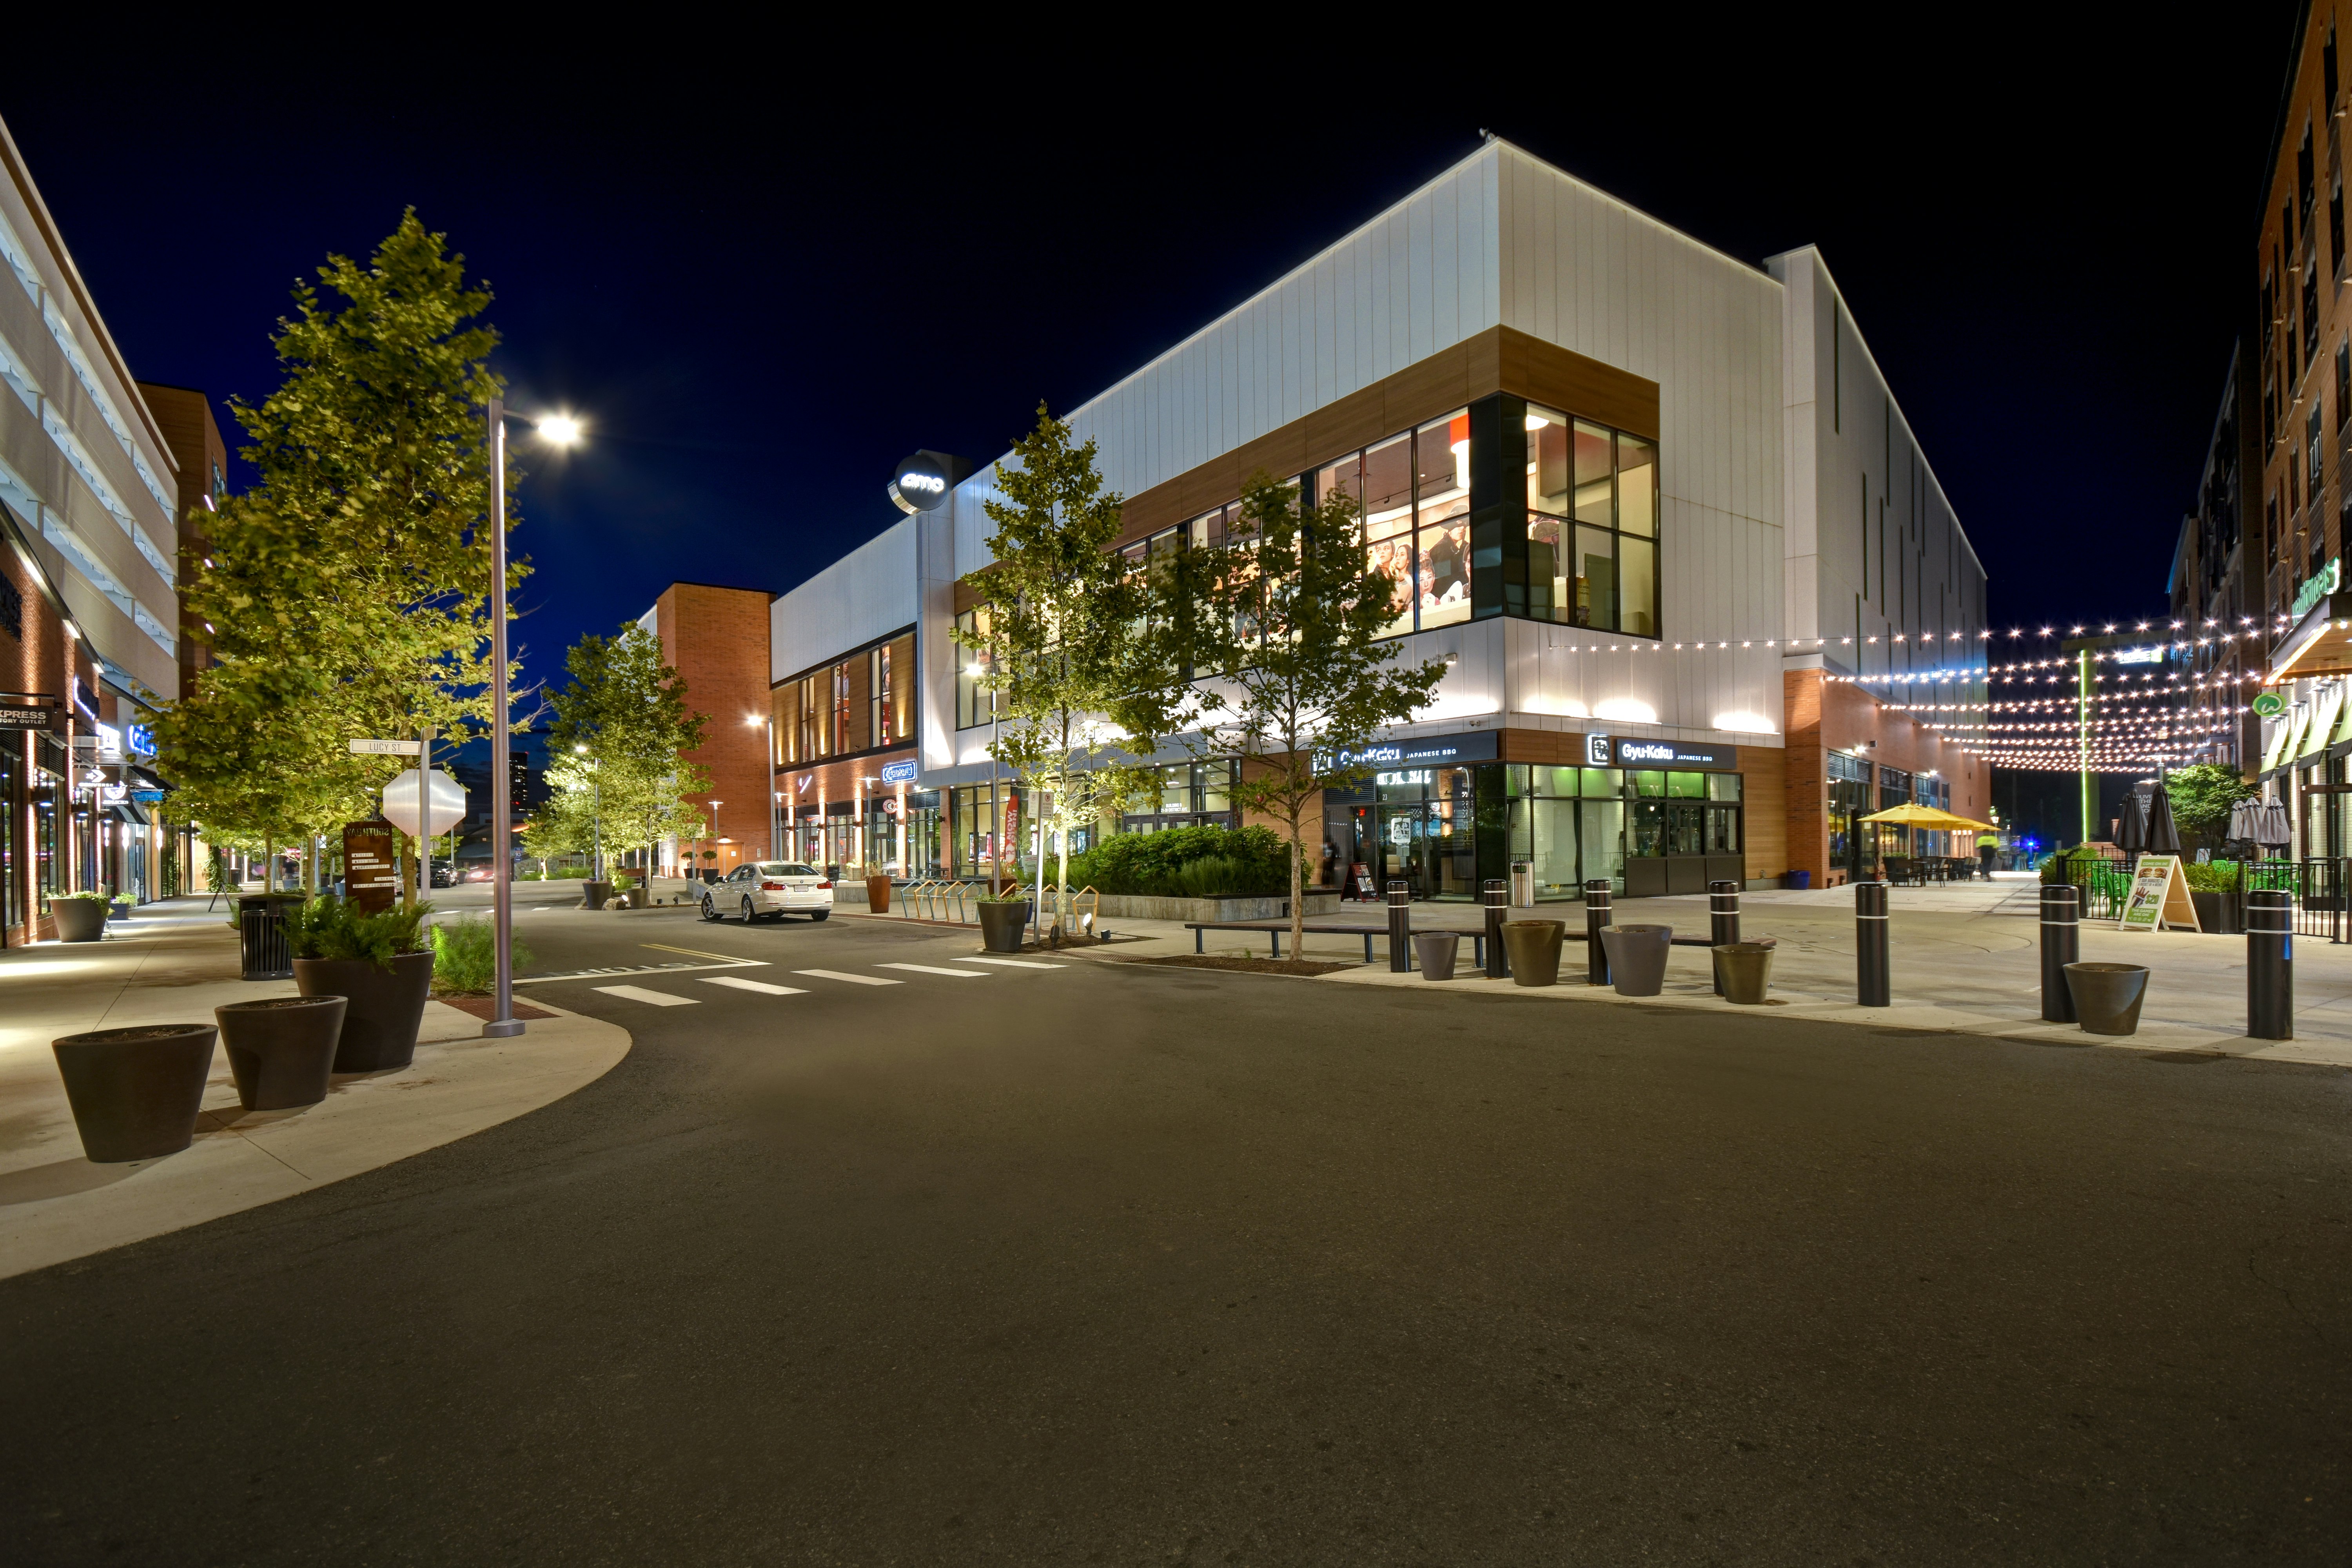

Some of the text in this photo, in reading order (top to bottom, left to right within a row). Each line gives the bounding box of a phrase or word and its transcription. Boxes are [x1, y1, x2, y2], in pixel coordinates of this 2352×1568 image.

[901, 473, 944, 492] amc
[392, 744, 403, 752] ST.
[1622, 744, 1673, 760] Gyu-Kaku
[1406, 750, 1439, 759] JAPANESE
